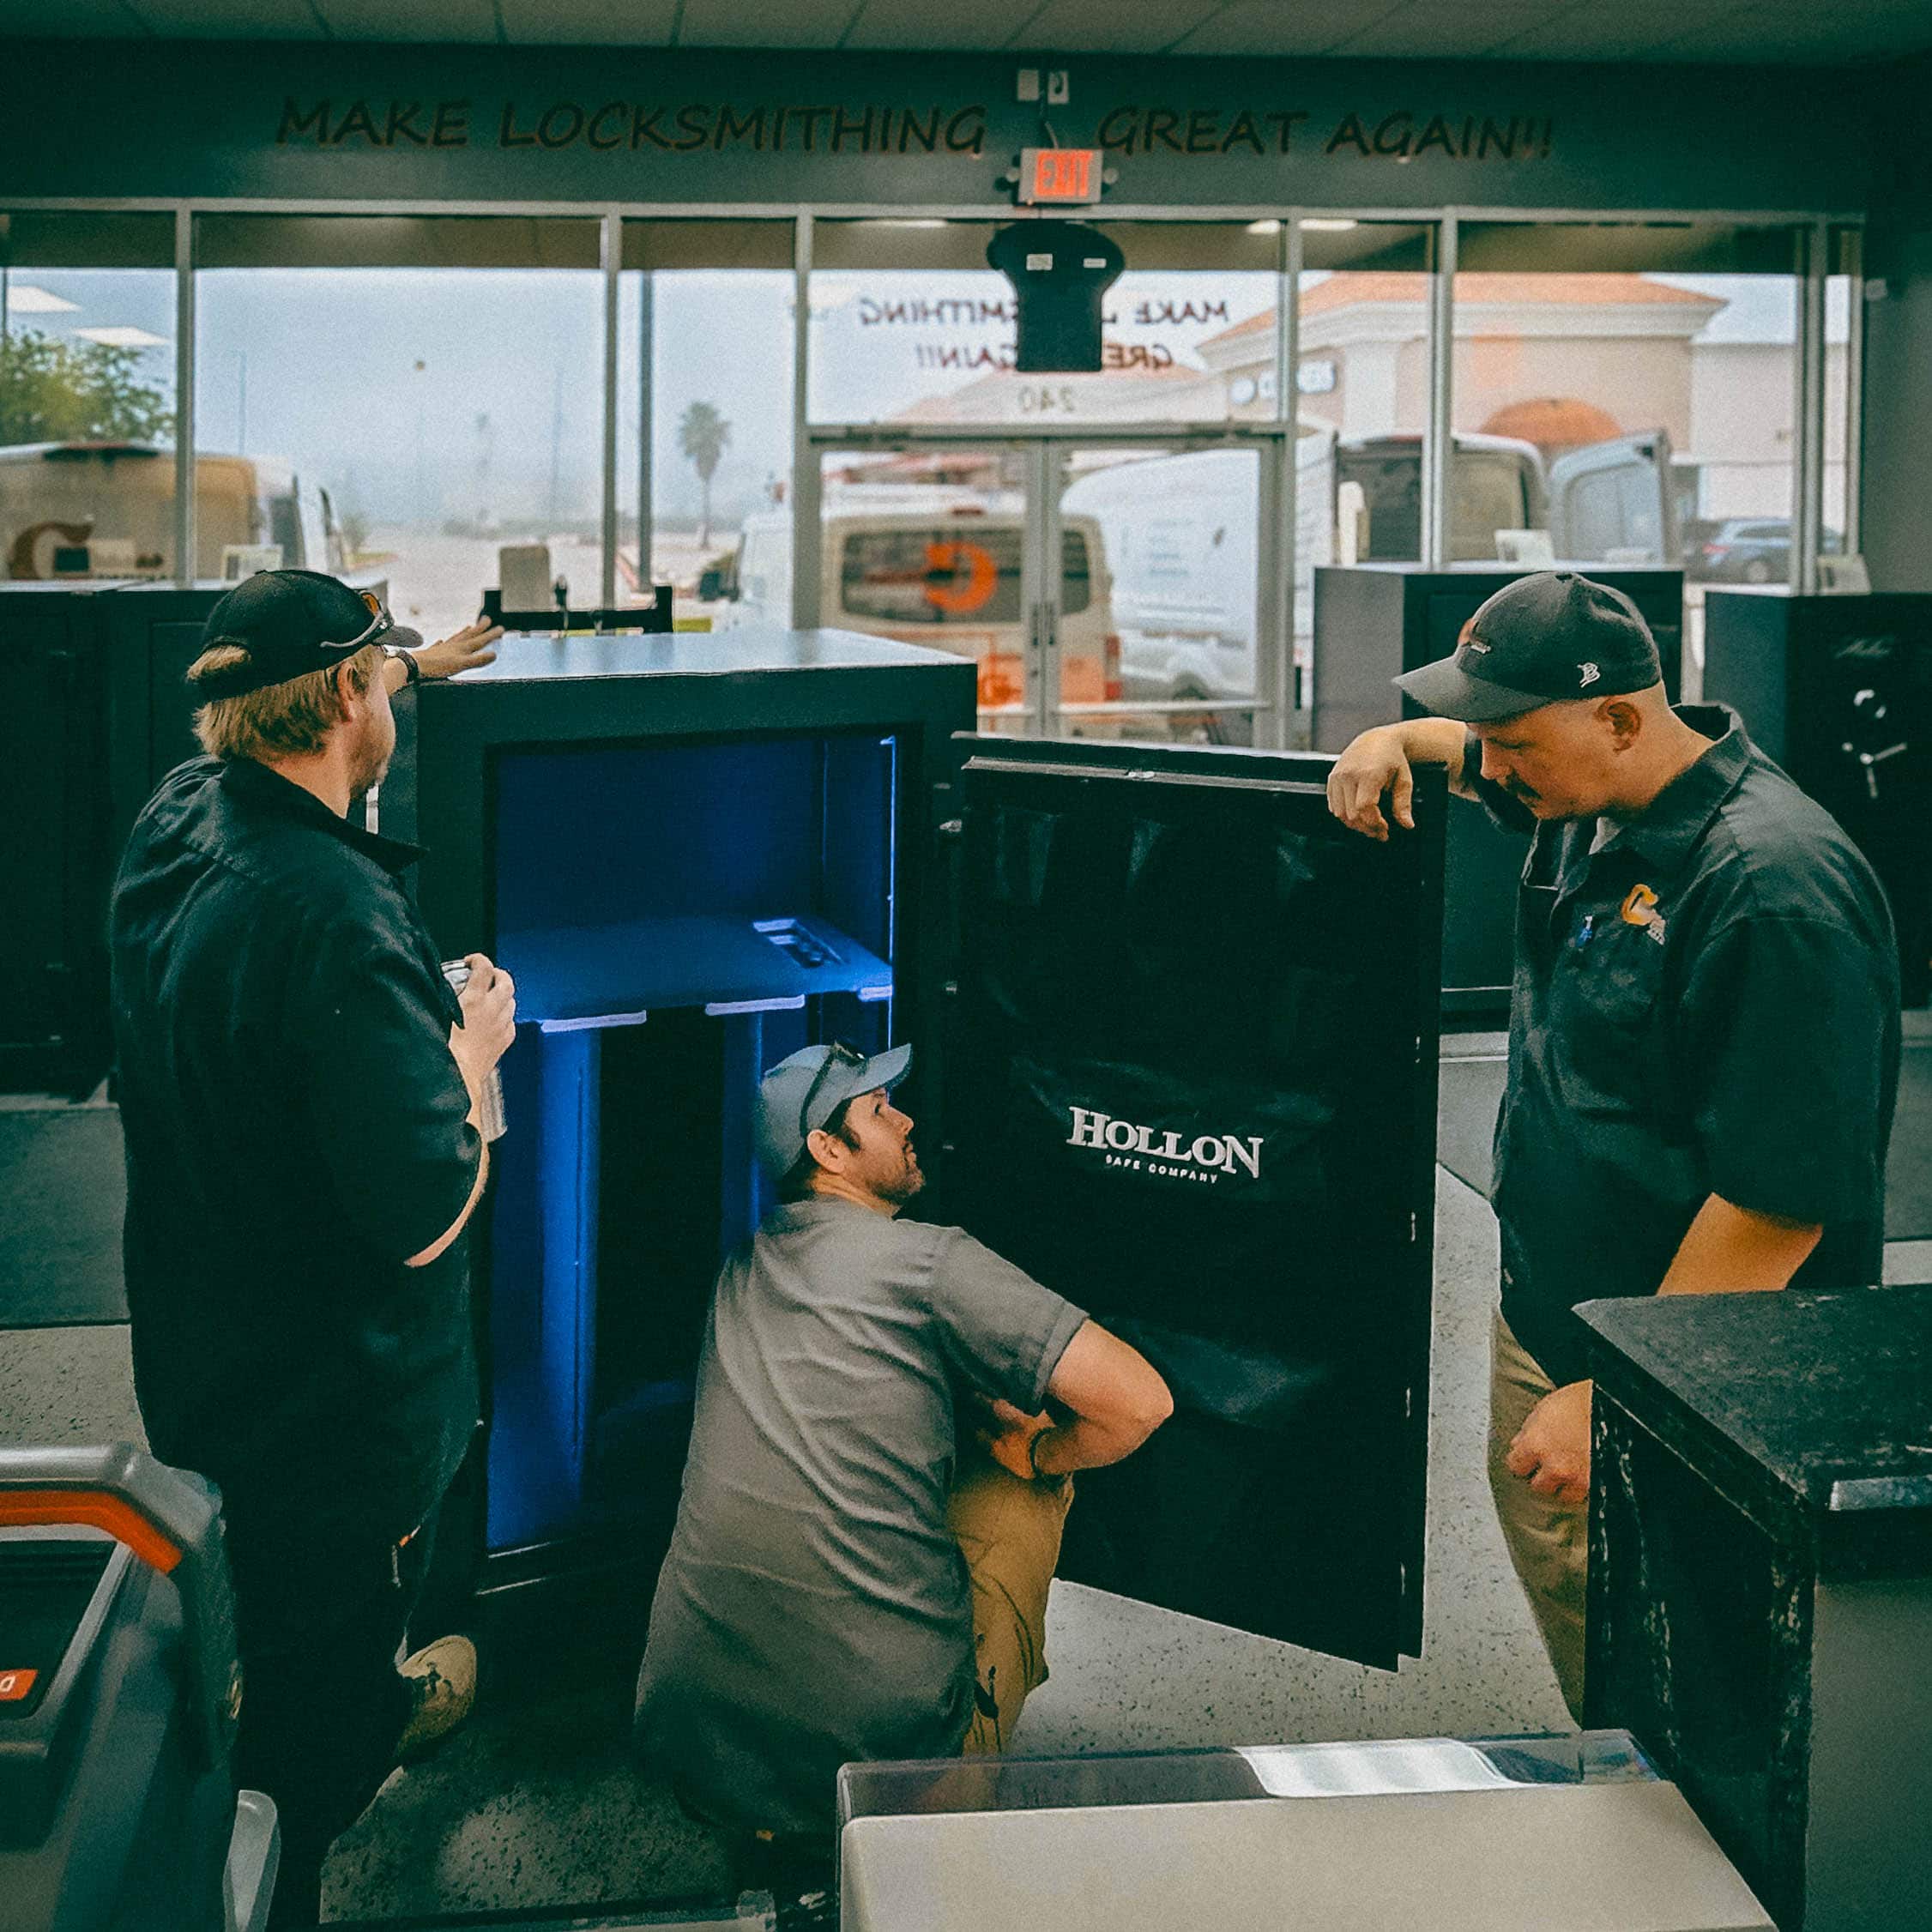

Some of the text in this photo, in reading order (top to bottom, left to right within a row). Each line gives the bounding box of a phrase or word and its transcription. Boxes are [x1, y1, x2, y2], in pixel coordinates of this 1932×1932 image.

[275, 96, 1555, 160] MAKE LOCKSMITHING GREAT AGAIN!!
[1035, 151, 1094, 197] EXIT
[1066, 1106, 1264, 1179] HOLLON
[1105, 1154, 1218, 1184] SAFE COMPANY
